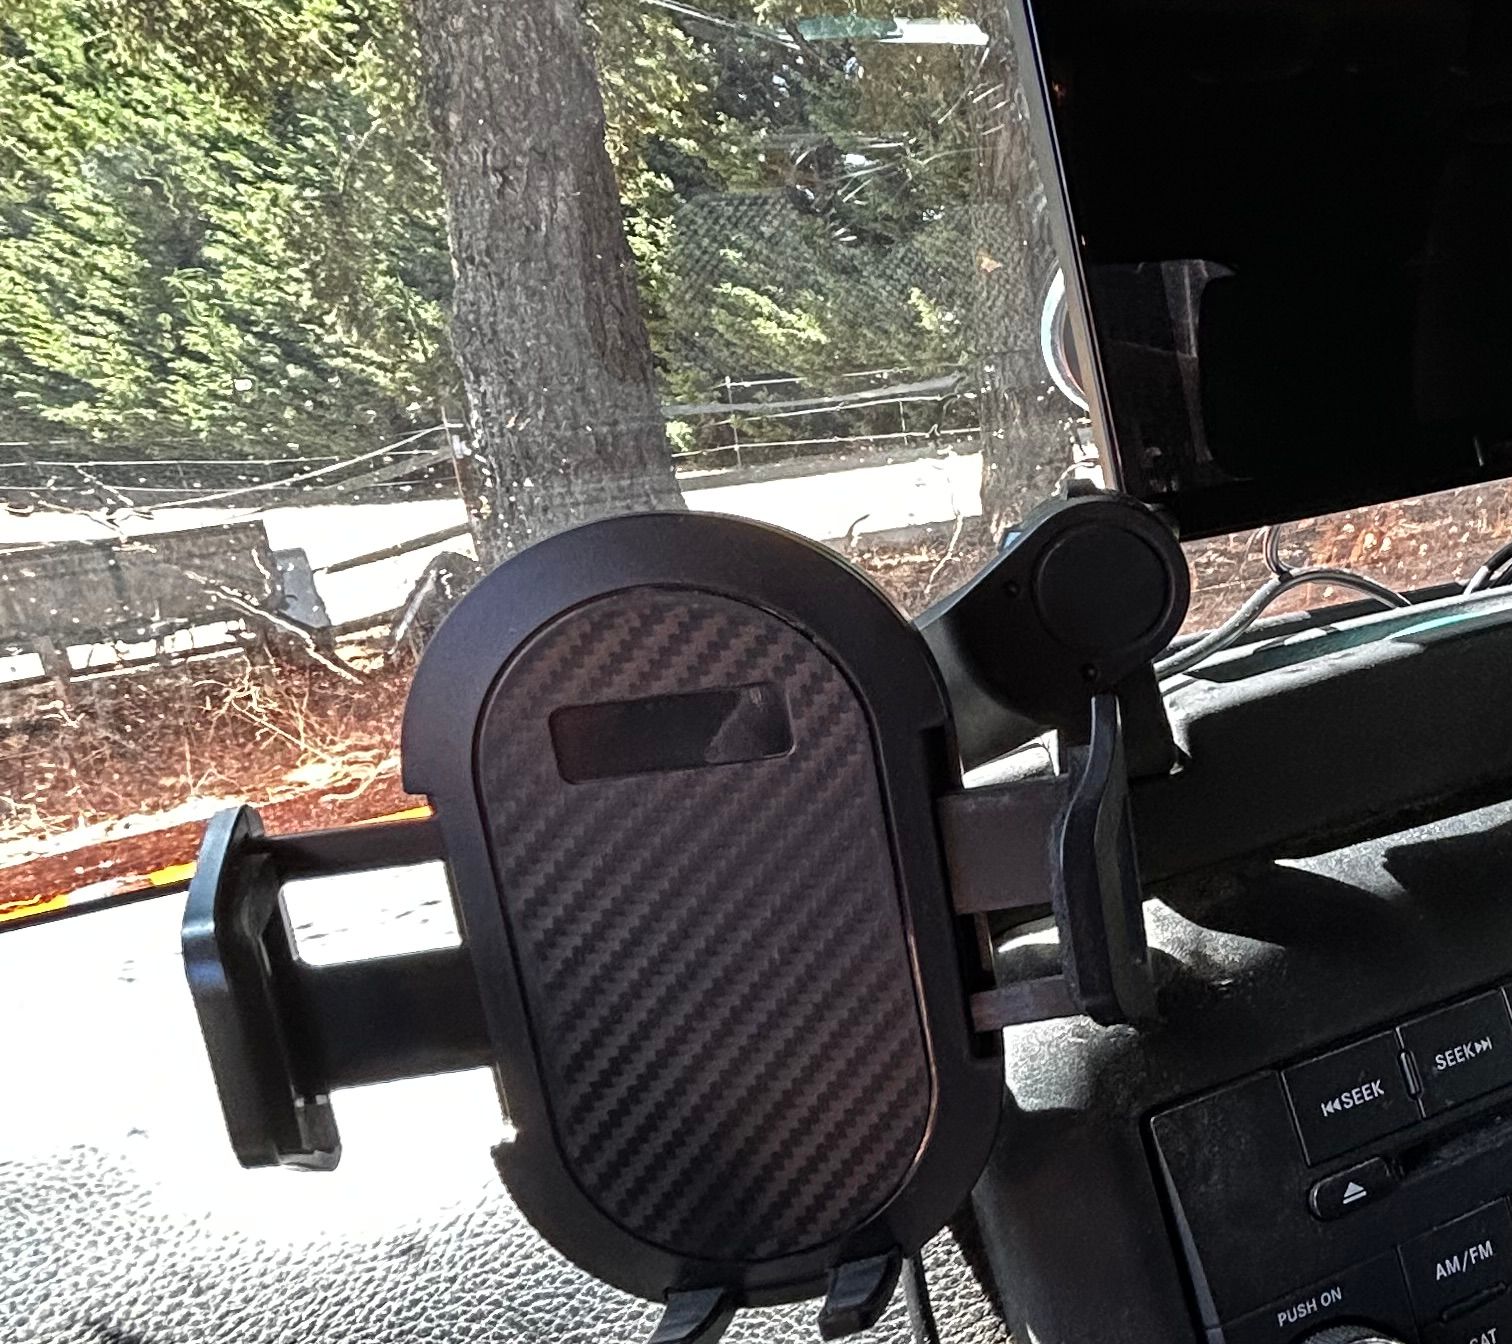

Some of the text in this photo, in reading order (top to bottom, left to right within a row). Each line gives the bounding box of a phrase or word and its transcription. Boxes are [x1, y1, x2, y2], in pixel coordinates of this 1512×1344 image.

[1435, 1040, 1476, 1071] SEEK
[1341, 1078, 1385, 1110] SEEK
[1435, 1240, 1493, 1280] AM/FM
[1277, 1286, 1343, 1327] PUSH ON
